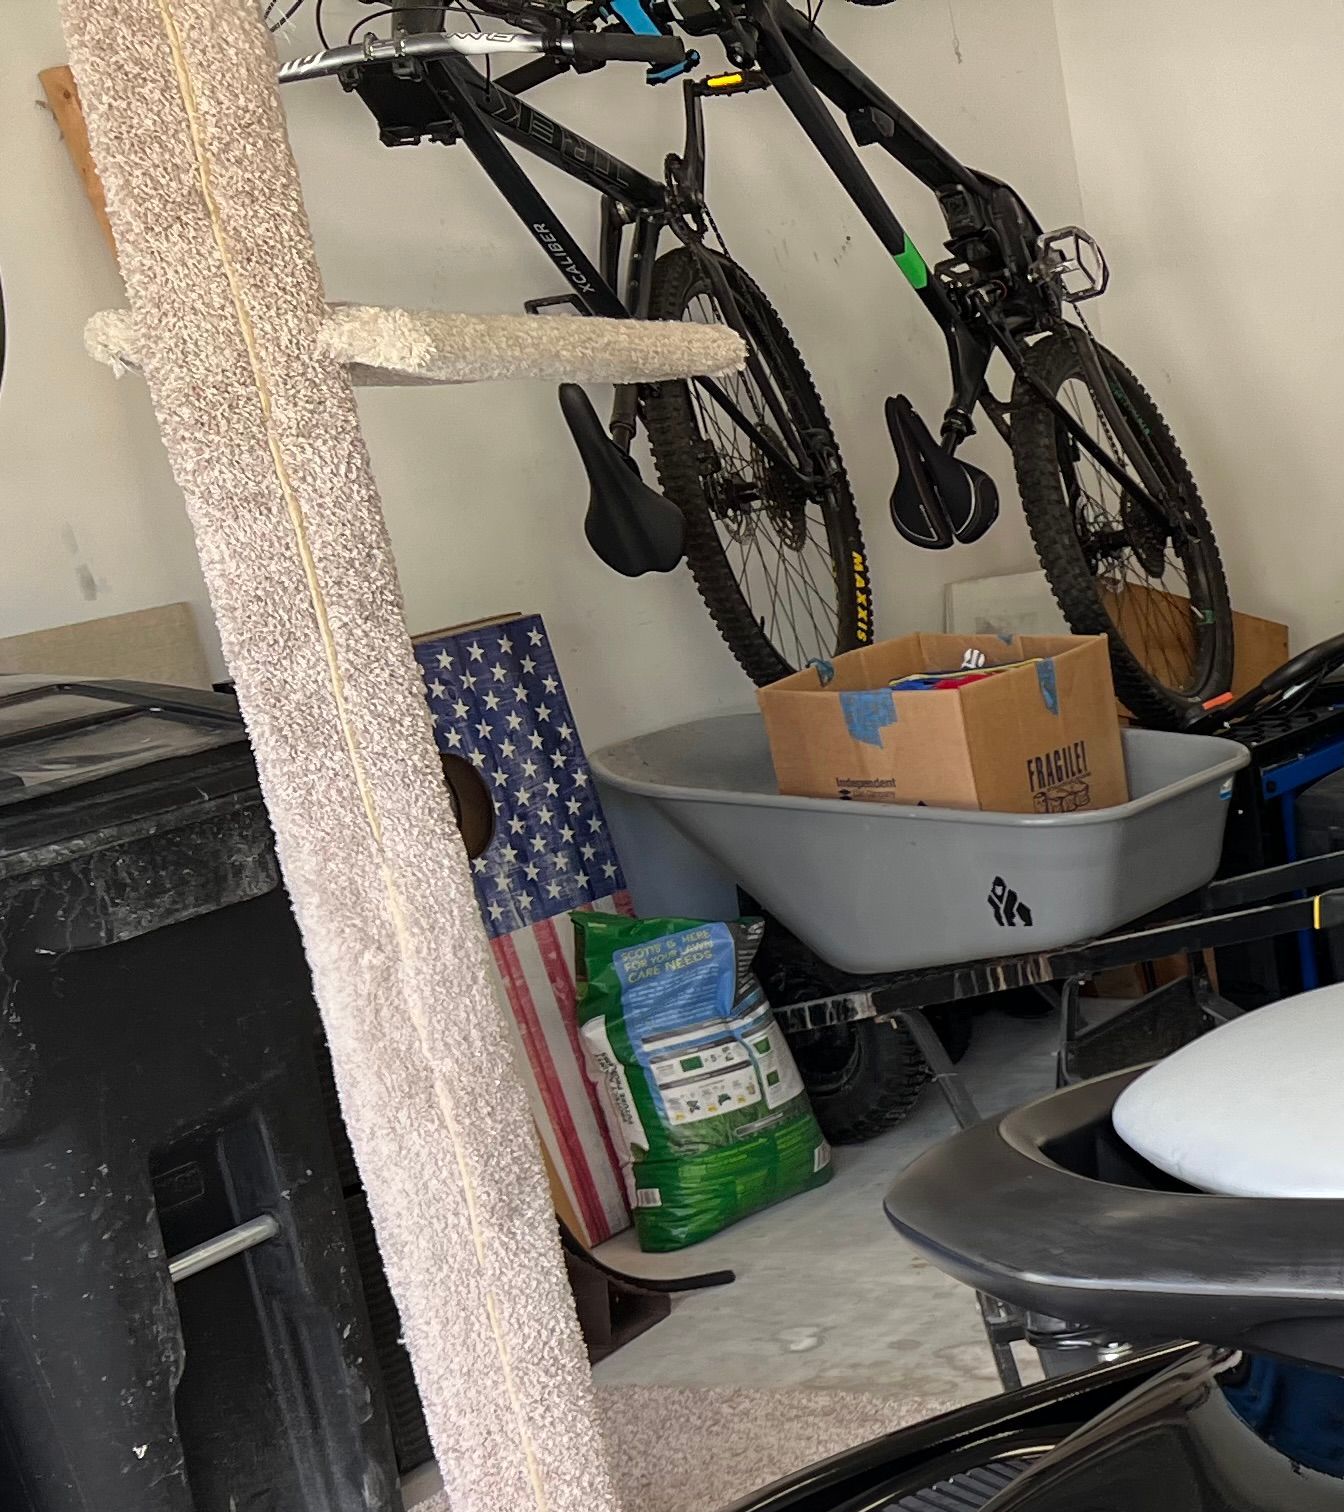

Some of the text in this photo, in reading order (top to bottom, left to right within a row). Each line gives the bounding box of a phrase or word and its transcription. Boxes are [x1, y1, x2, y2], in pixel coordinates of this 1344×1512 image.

[490, 86, 631, 187] TREK
[533, 222, 595, 294] XCALIBER
[852, 551, 868, 642] MAXXIS
[836, 777, 896, 789] Independent
[1026, 740, 1089, 792] FRAGILE!
[628, 952, 713, 983] CARE NEEDS
[650, 950, 678, 965] YOUR
